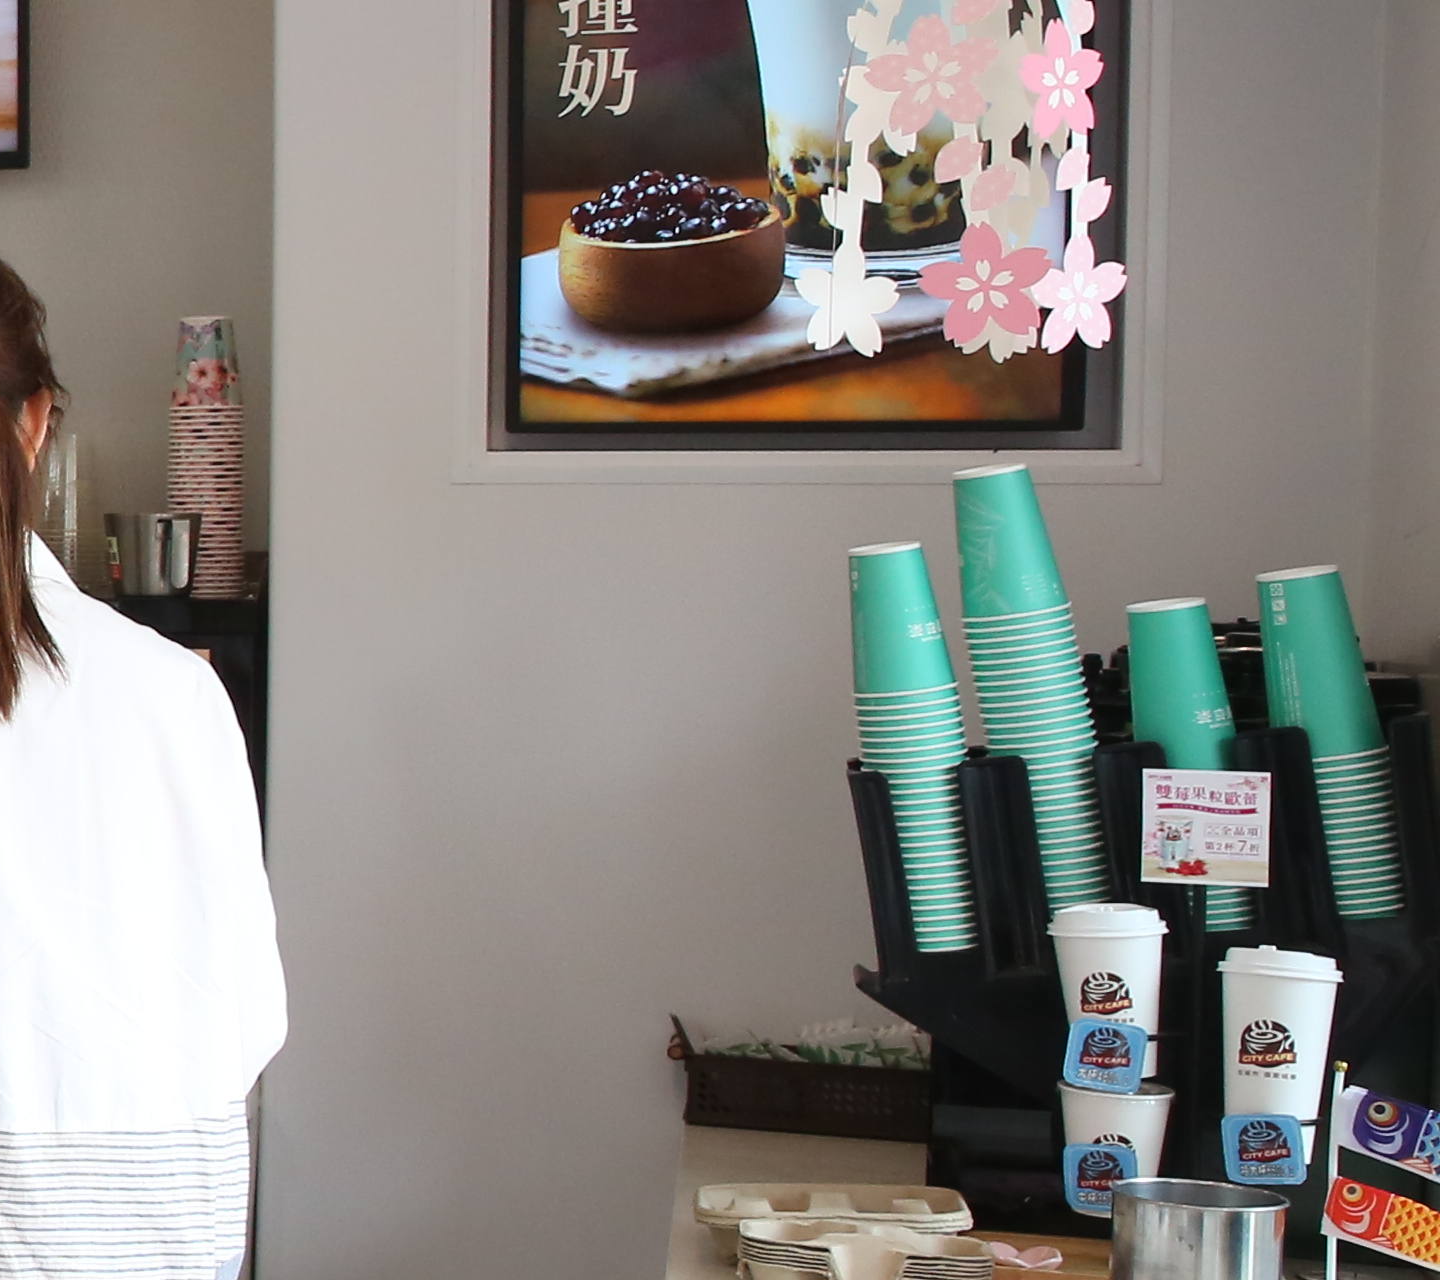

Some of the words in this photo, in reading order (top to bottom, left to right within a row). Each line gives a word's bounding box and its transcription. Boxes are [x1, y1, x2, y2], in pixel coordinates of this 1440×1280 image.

[1155, 784, 1258, 806] 雙莓果粒歐蕾
[1105, 1000, 1130, 1009] CAFE
[1265, 1053, 1293, 1062] CAFE
